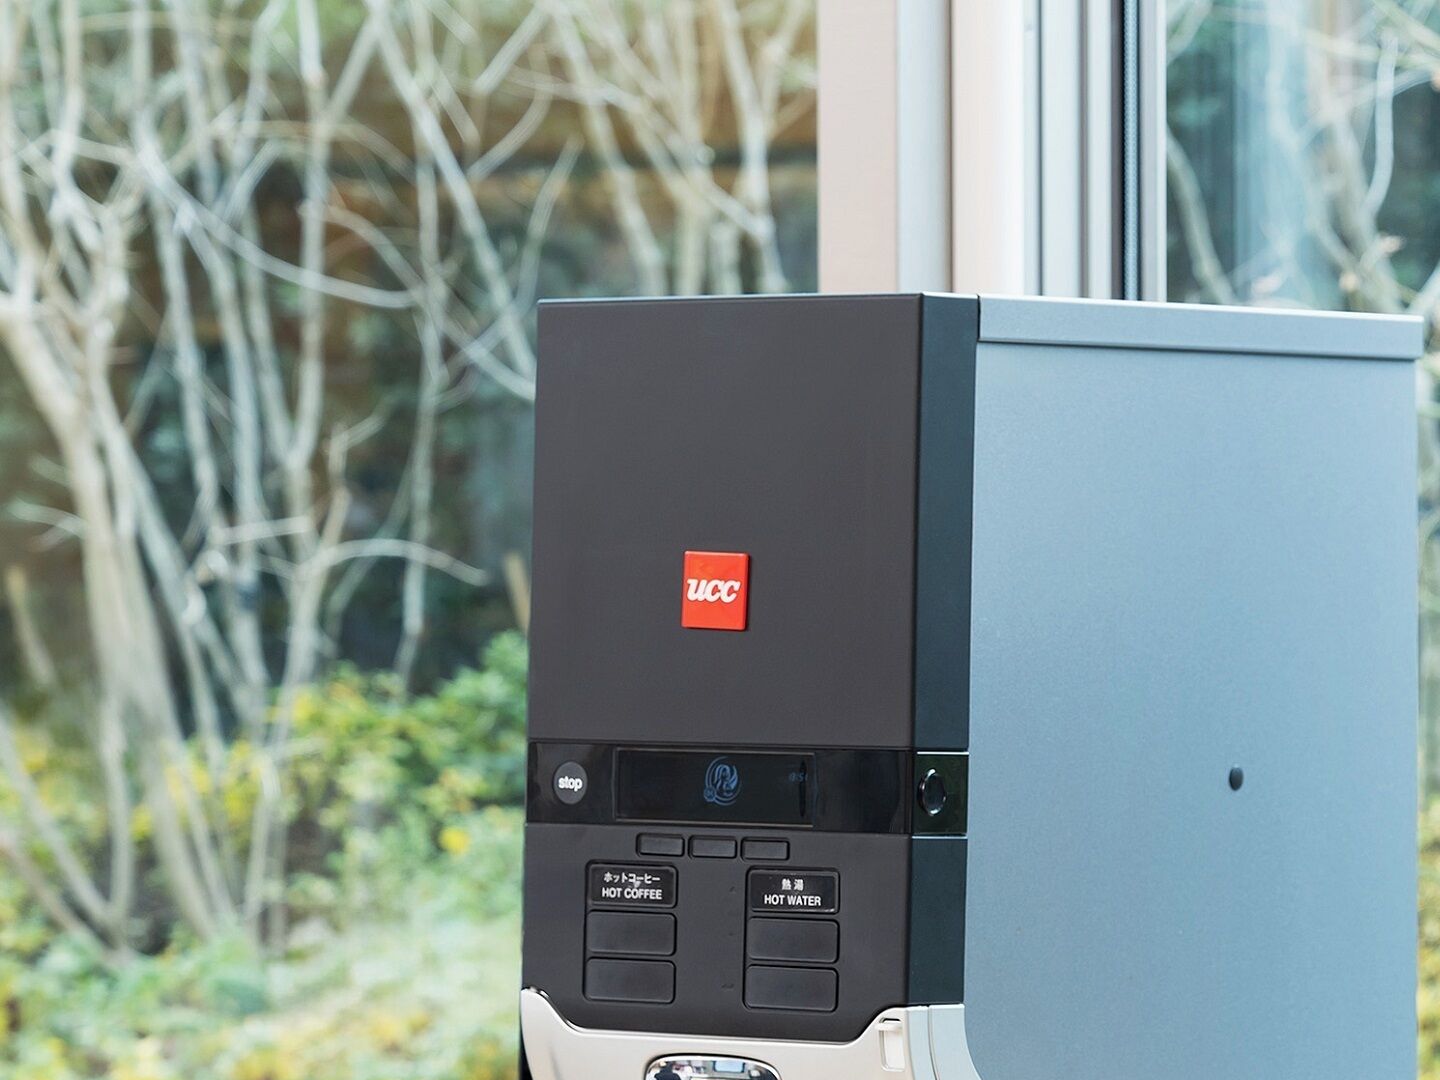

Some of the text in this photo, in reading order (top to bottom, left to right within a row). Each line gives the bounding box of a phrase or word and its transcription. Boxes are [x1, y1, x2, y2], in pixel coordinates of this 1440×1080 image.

[558, 776, 583, 792] stop
[603, 872, 661, 884] ホットコーヒー
[602, 887, 662, 900] HOT COFFEE
[764, 894, 821, 907] HOT WATER
